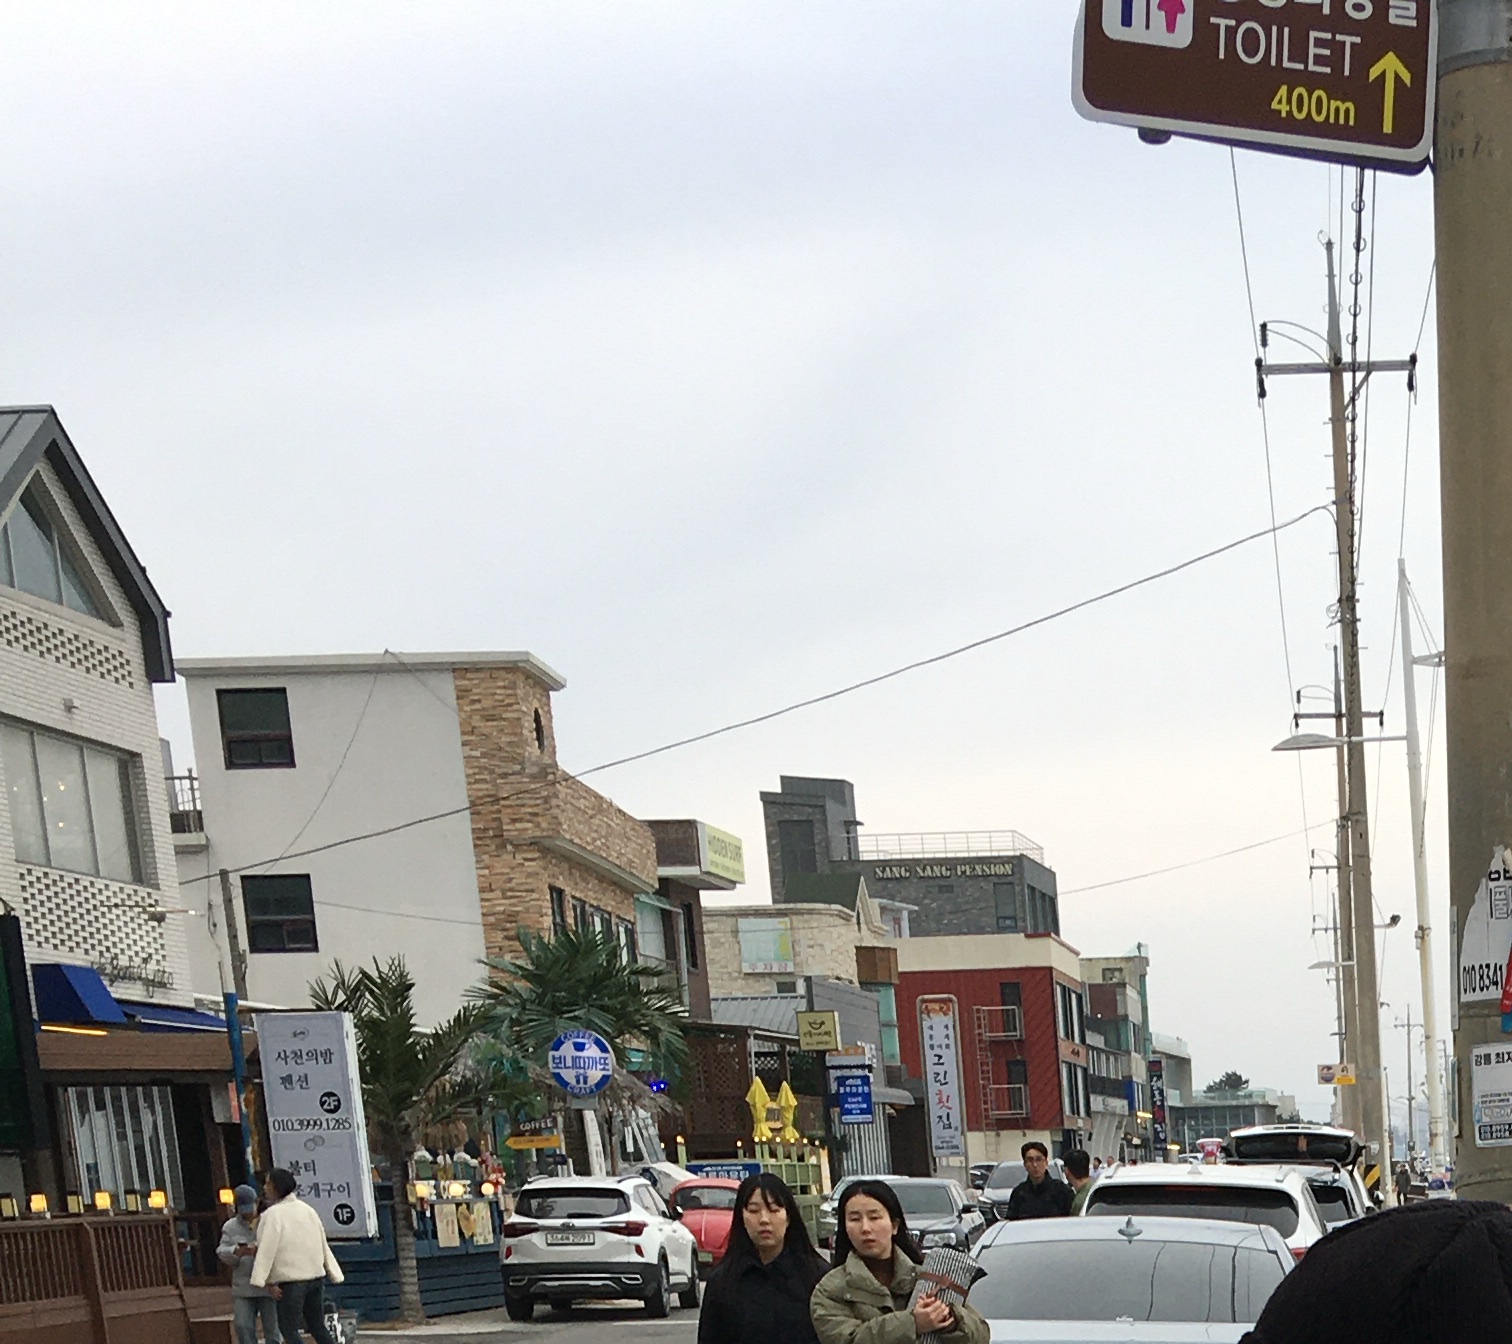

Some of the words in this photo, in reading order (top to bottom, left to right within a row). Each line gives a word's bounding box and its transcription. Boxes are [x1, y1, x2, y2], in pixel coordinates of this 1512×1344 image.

[1209, 16, 1362, 77] TOILET
[1271, 84, 1356, 126] 400m
[875, 866, 911, 879] SANG
[915, 865, 951, 878] SANG
[956, 863, 1014, 876] PENSION
[1462, 964, 1477, 995] 010
[1478, 962, 1504, 993] 8341
[561, 1030, 597, 1042] COFFEE
[551, 1054, 610, 1072] 보니따까또
[932, 1053, 953, 1131] 그린횟집
[321, 1096, 339, 1110] 2F
[520, 1118, 553, 1131] COFFEE
[336, 1208, 352, 1222] 1F
